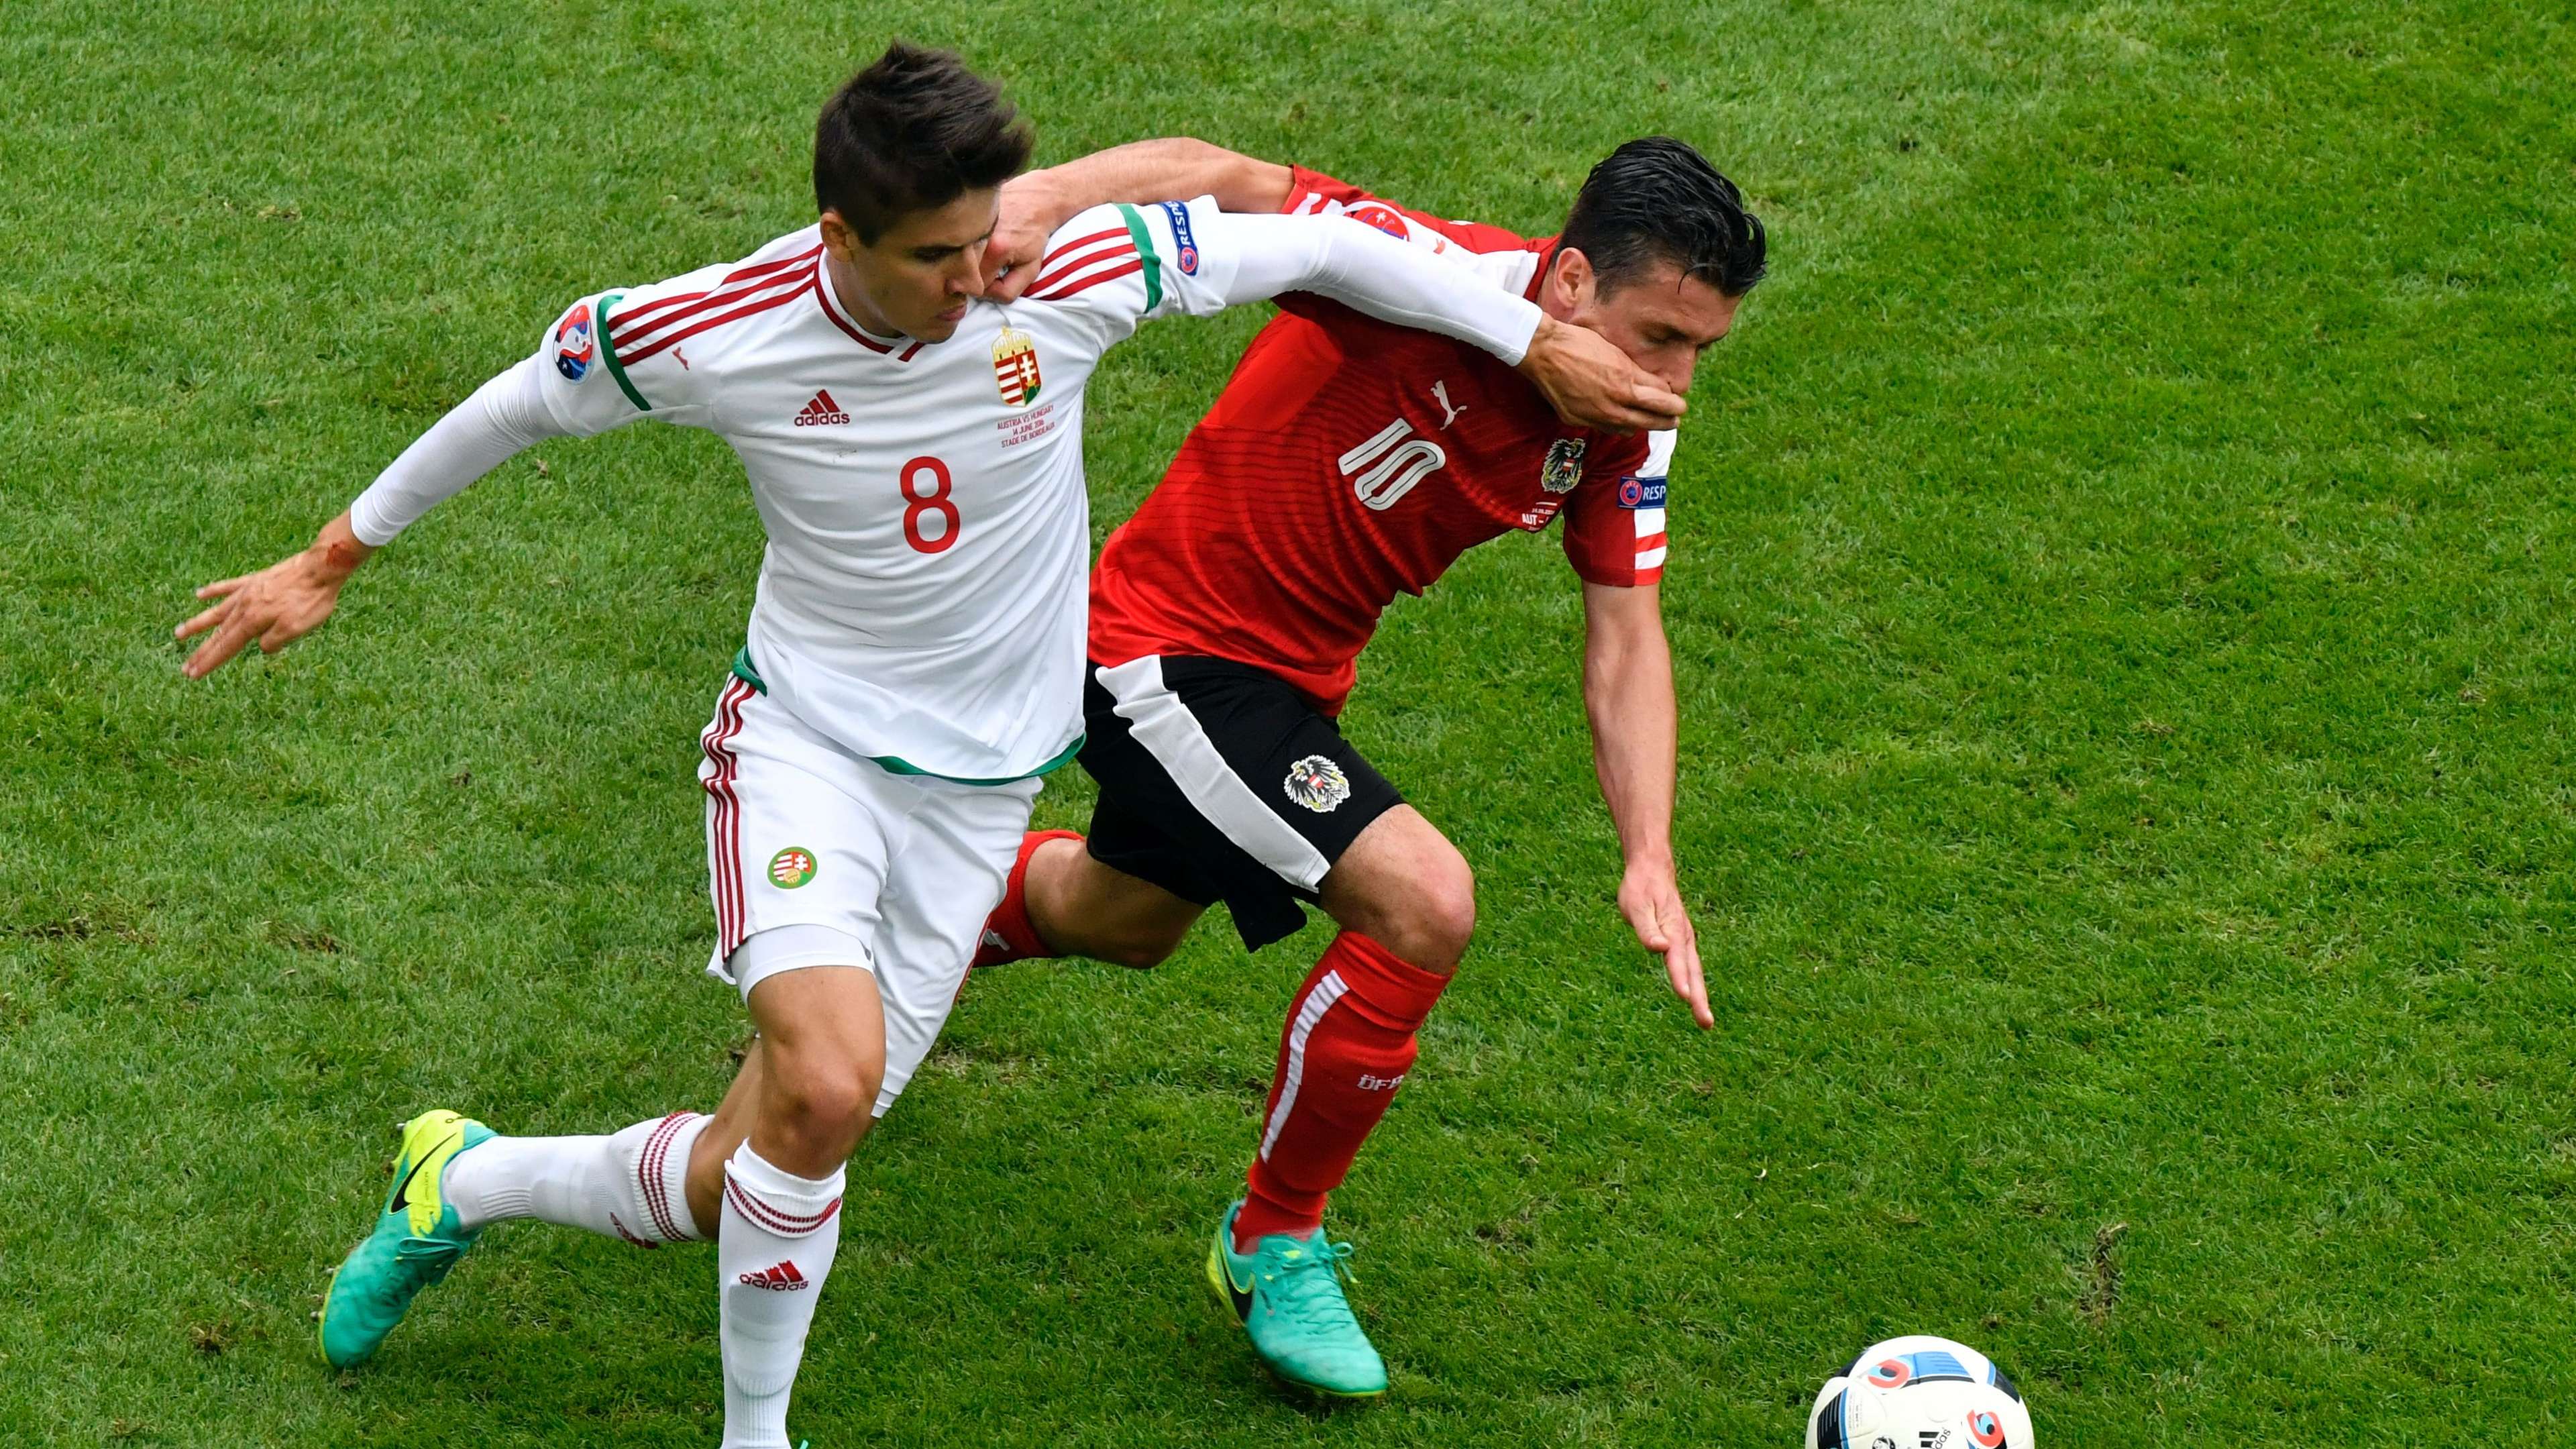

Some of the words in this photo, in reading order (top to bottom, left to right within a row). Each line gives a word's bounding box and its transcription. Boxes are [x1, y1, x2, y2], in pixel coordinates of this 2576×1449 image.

[794, 412, 850, 427] adidas
[997, 417, 1021, 430] AUSTRIA
[1030, 405, 1054, 419] HUNGARY
[1002, 437, 1020, 448] STADE
[1029, 421, 1055, 439] BORDEAUX
[1019, 423, 1032, 435] JUNE
[1338, 417, 1446, 511] 10
[1642, 485, 1666, 501] RESP
[900, 455, 961, 554] 8
[1521, 513, 1538, 525] AUT
[739, 1273, 809, 1291] adidas
